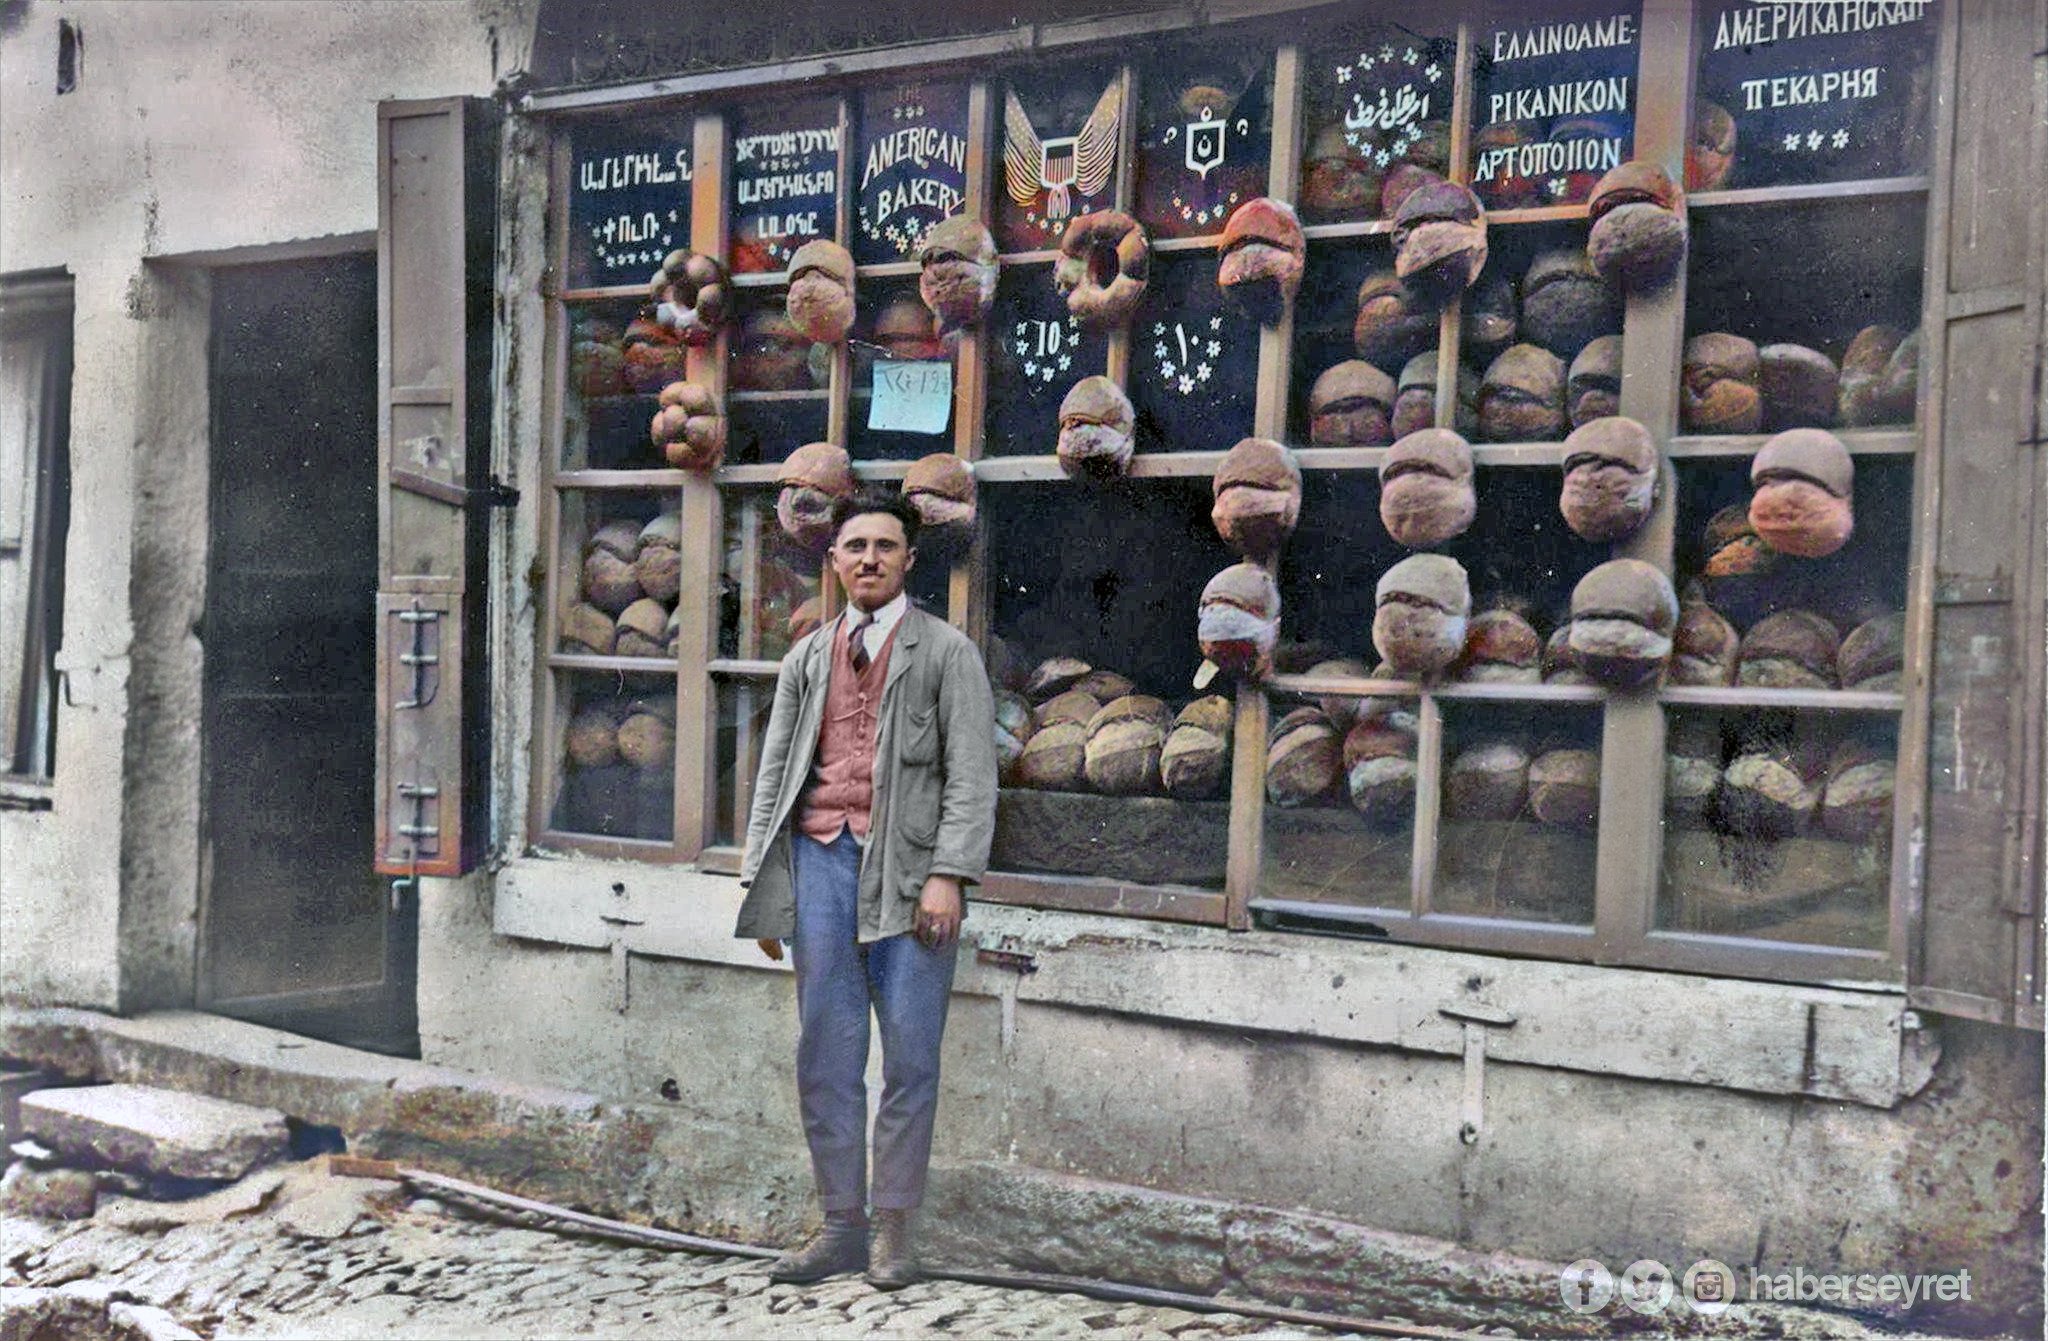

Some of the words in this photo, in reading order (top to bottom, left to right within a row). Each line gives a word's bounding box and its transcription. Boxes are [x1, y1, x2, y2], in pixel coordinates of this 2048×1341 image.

[1741, 67, 1880, 111] ПЕКАРНЯ
[860, 126, 967, 191] AMERICAN
[877, 178, 966, 225] BAKERY
[1034, 320, 1061, 356] 10
